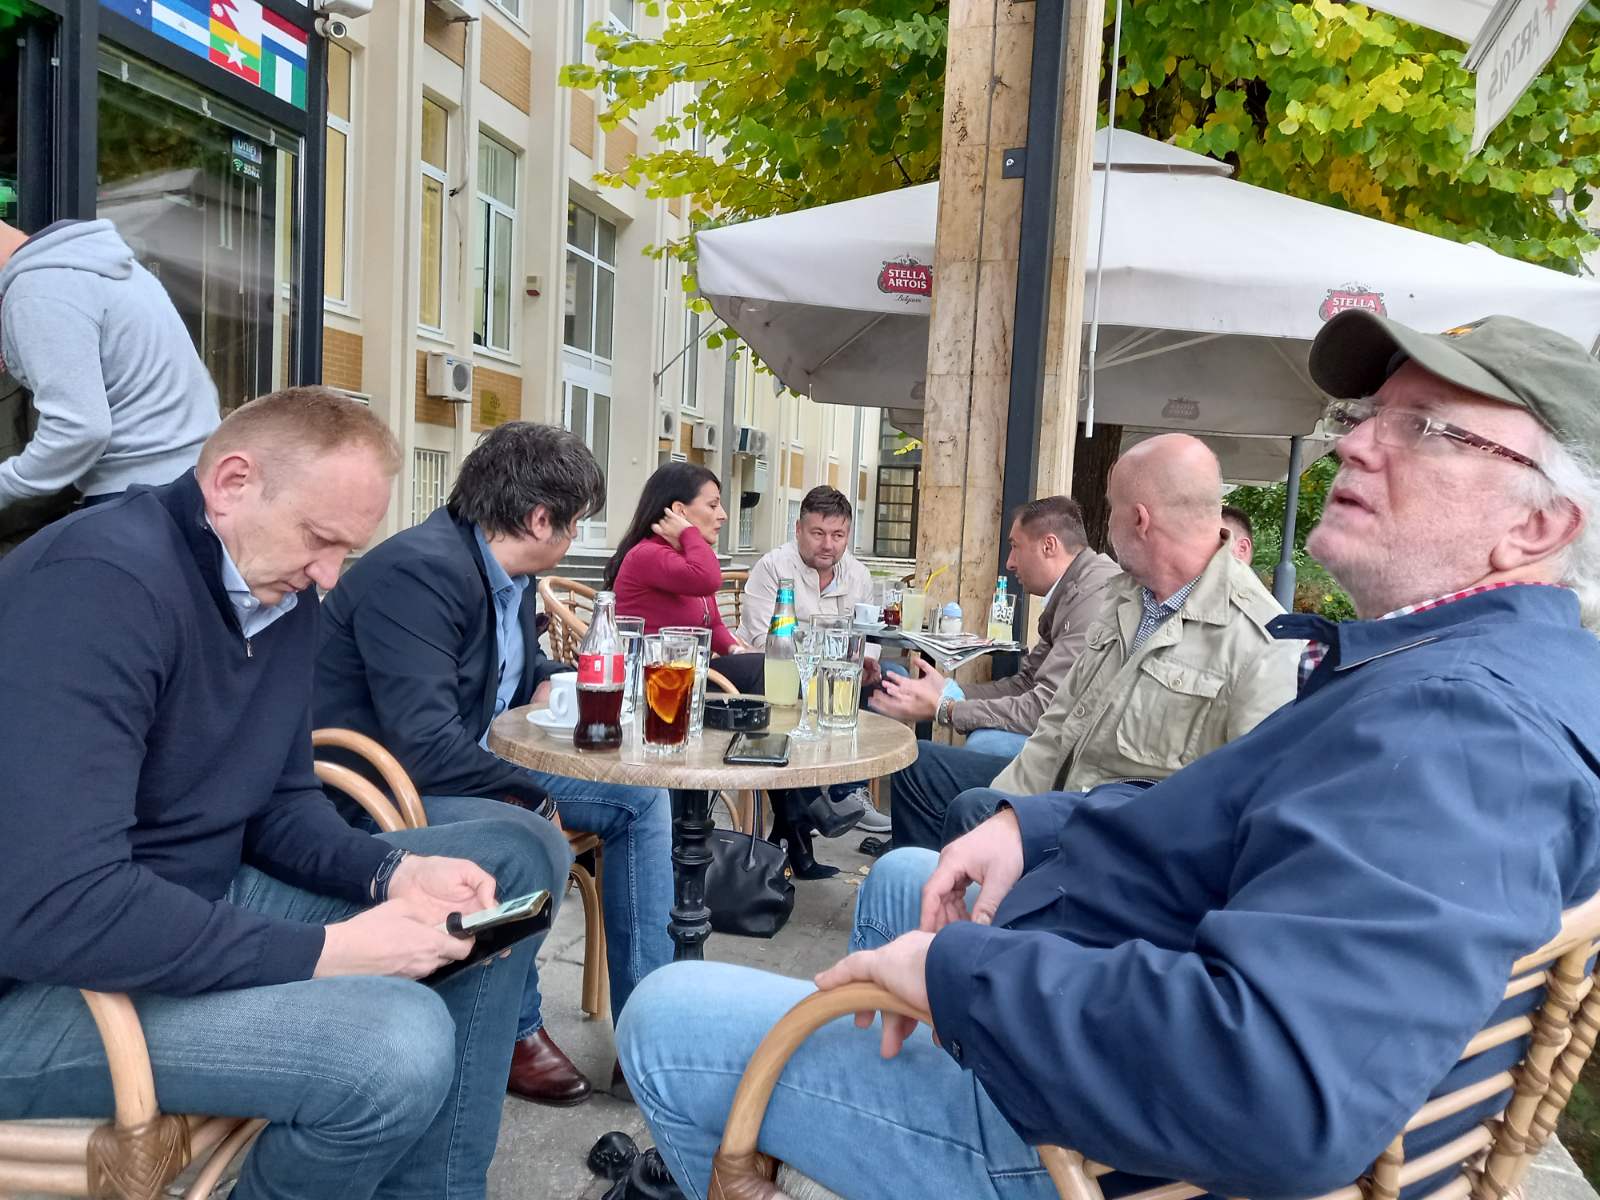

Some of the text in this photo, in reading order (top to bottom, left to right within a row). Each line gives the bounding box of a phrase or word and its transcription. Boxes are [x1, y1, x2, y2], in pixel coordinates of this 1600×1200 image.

[888, 269, 926, 280] STELLA
[888, 278, 927, 289] ARTOIS
[1332, 297, 1376, 308] STELLA
